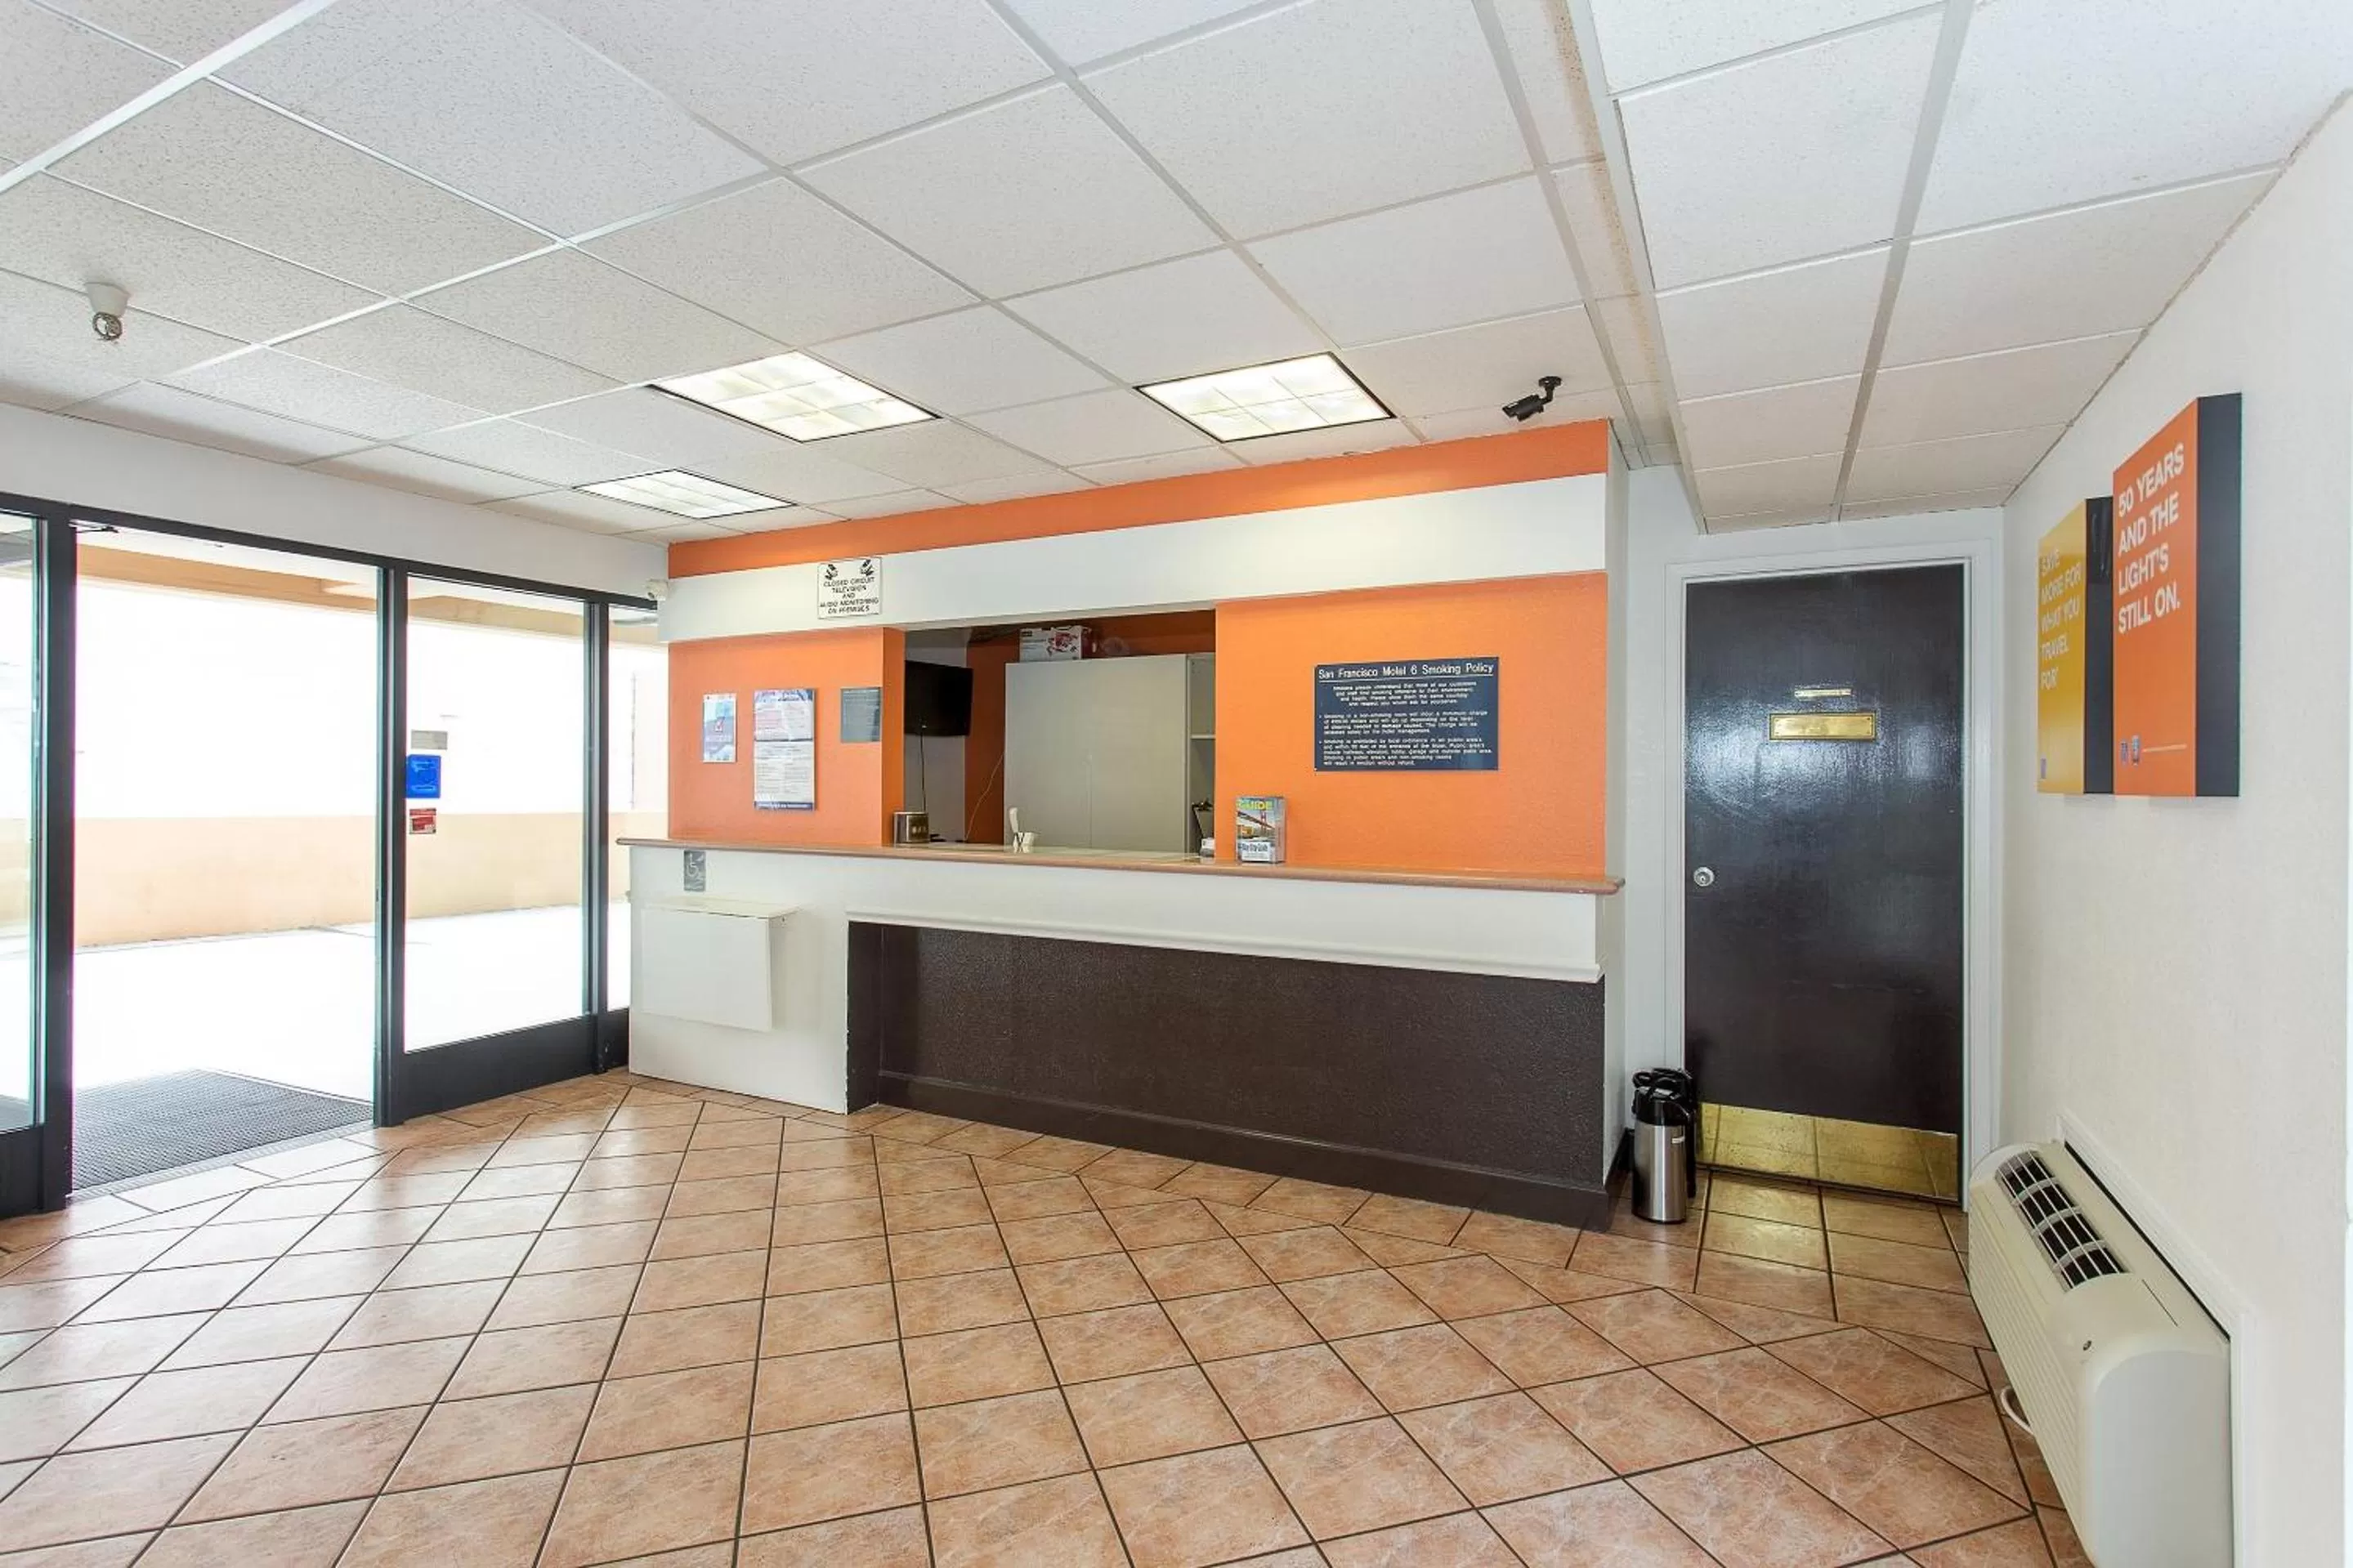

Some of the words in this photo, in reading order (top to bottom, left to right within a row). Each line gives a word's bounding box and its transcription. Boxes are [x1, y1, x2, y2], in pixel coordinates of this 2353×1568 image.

[2118, 487, 2134, 517] 50
[2136, 442, 2185, 503] YEARS
[2118, 516, 2146, 557] AND
[2149, 491, 2180, 535] THE
[2041, 574, 2064, 605] MORE
[2064, 561, 2082, 589] FOR
[2064, 595, 2080, 621] YOU
[2118, 596, 2151, 634] STILL
[2154, 581, 2181, 618] ON.
[2040, 634, 2069, 660] TRAVEL
[1318, 668, 1335, 680] San
[1338, 667, 1378, 678] Francisco
[1383, 666, 1407, 677] Motel
[1411, 663, 1417, 675] 6
[1422, 663, 1461, 675] Smoking
[1465, 662, 1494, 673] Policy
